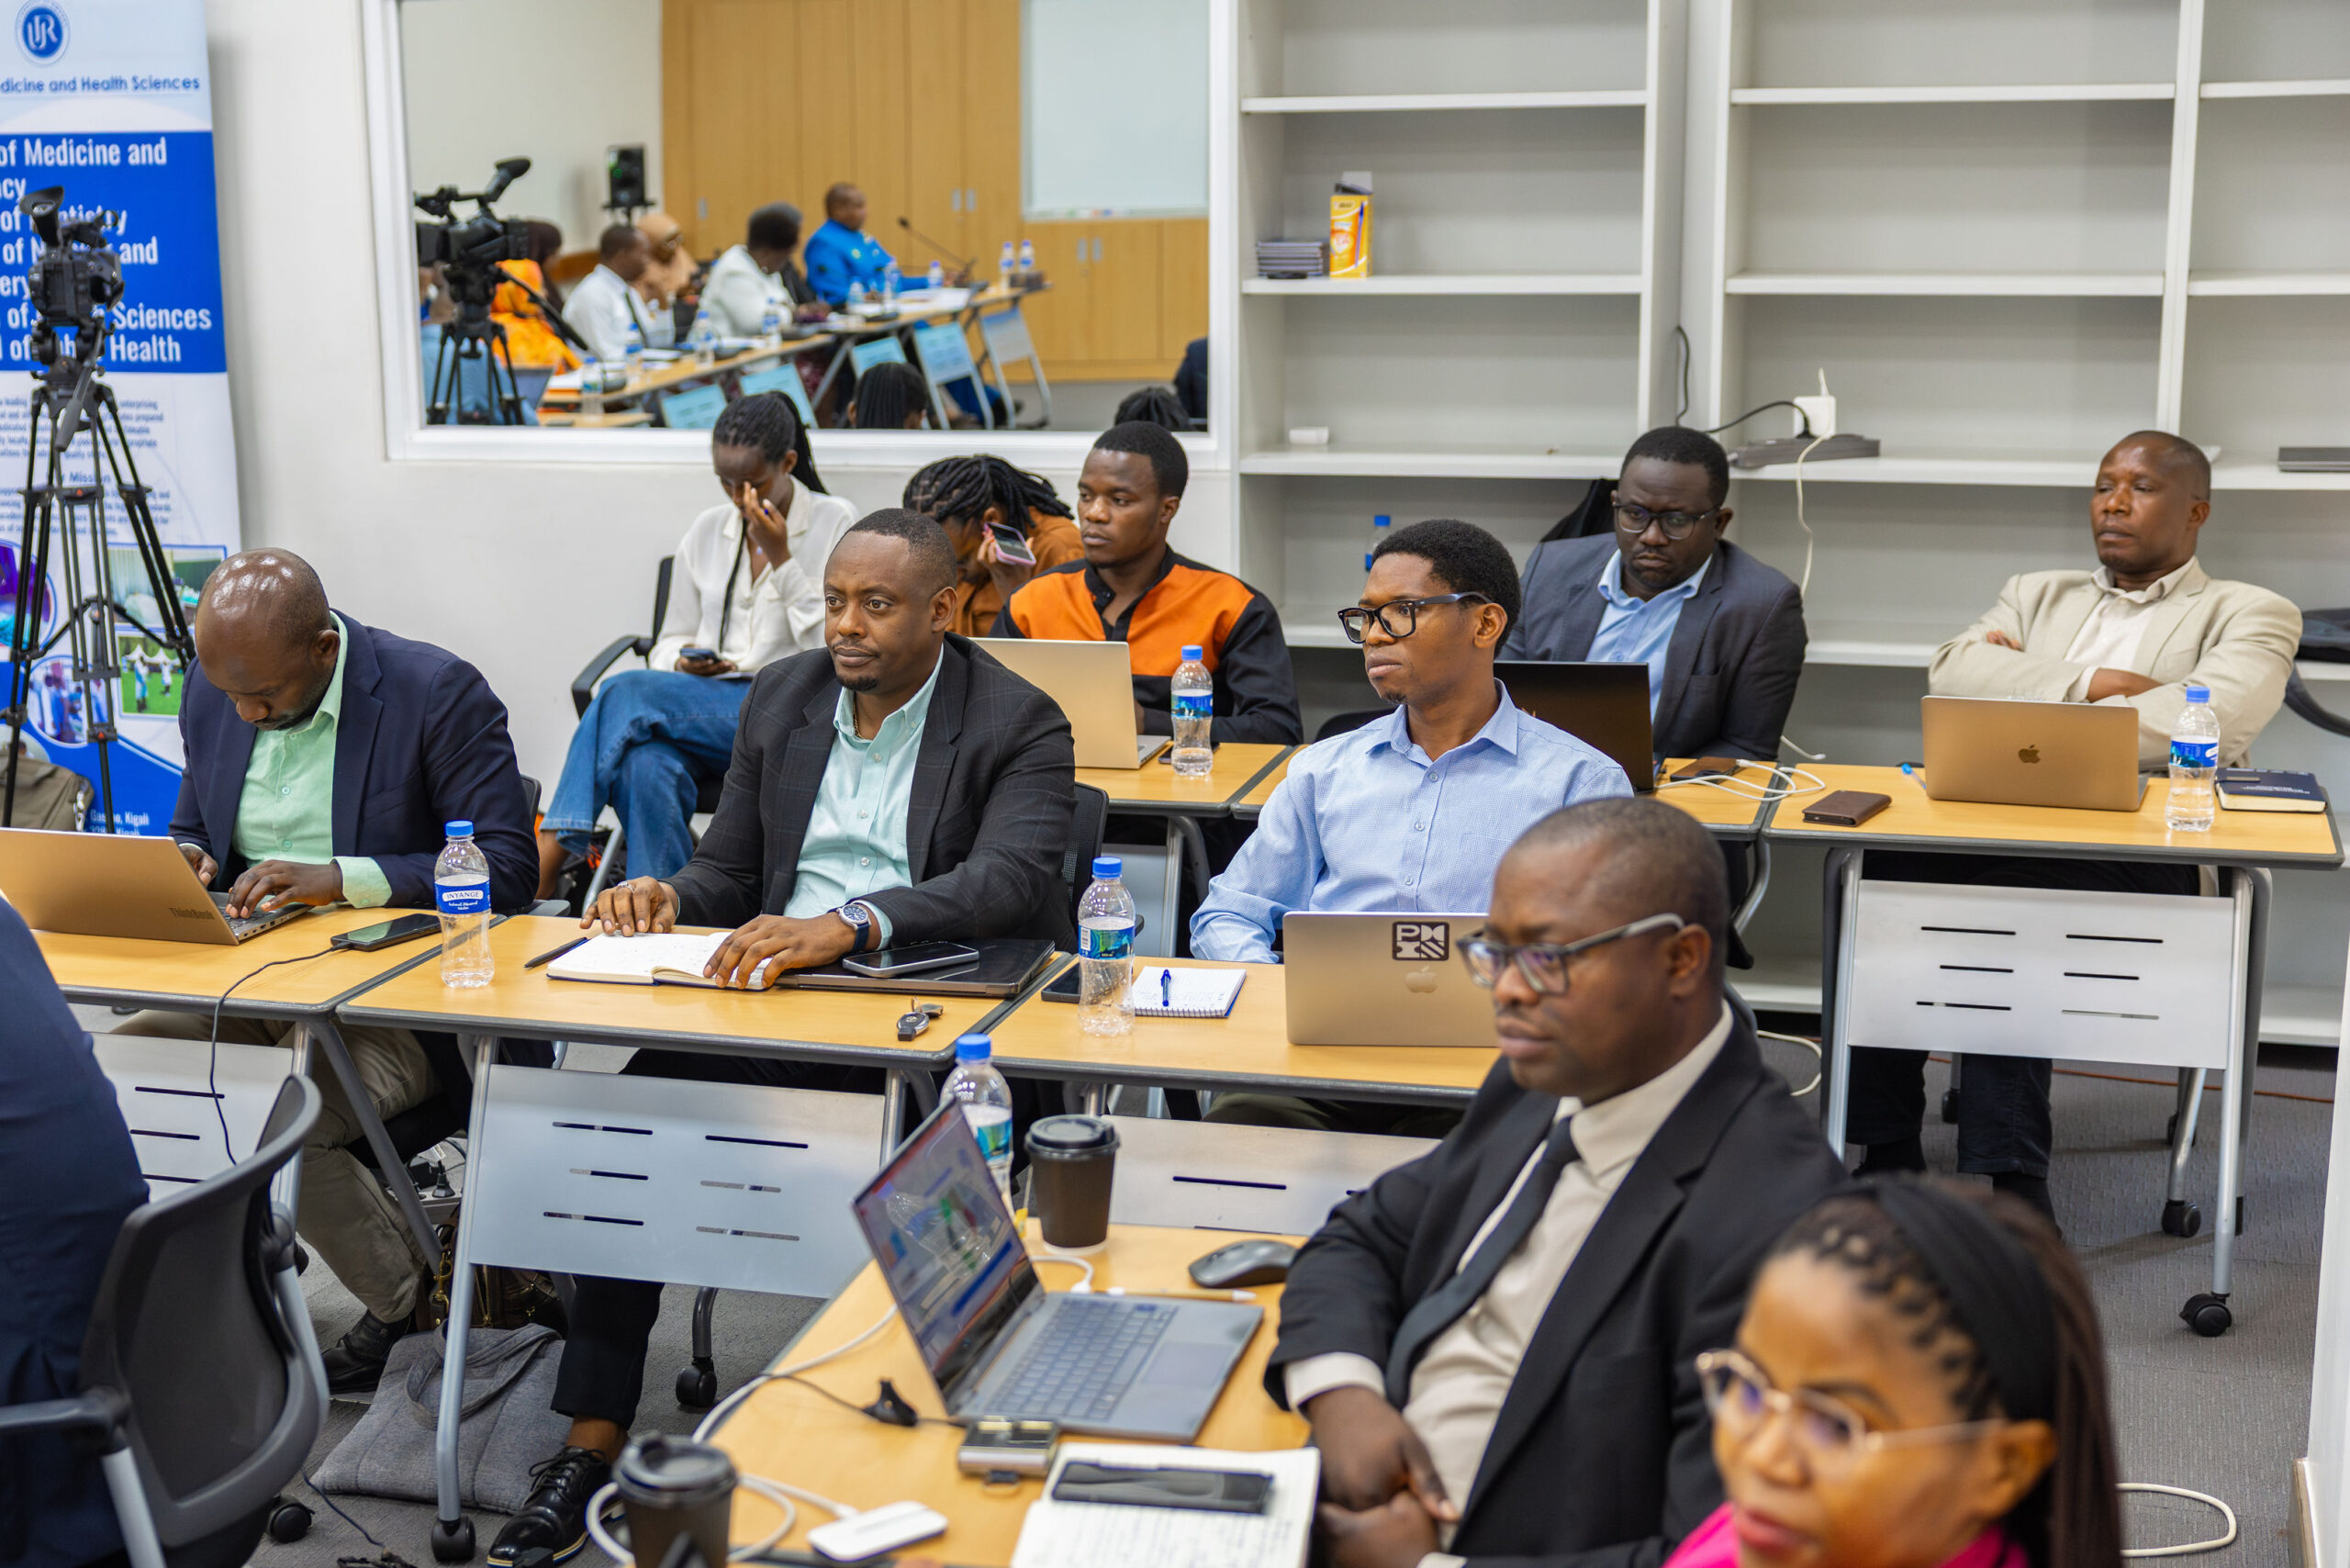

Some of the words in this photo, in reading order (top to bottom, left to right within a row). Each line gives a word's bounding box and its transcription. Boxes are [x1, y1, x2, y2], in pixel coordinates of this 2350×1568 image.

[49, 76, 76, 91] and
[81, 75, 128, 90] Health
[133, 75, 200, 89] Sciences
[24, 138, 120, 166] Medicine
[128, 137, 167, 165] and
[0, 178, 26, 203] cy
[1, 205, 21, 232] of
[3, 238, 23, 264] of
[119, 236, 158, 264] and
[7, 302, 28, 329] of
[111, 301, 212, 330] Sciences
[10, 333, 31, 361] of
[109, 334, 182, 362] Health
